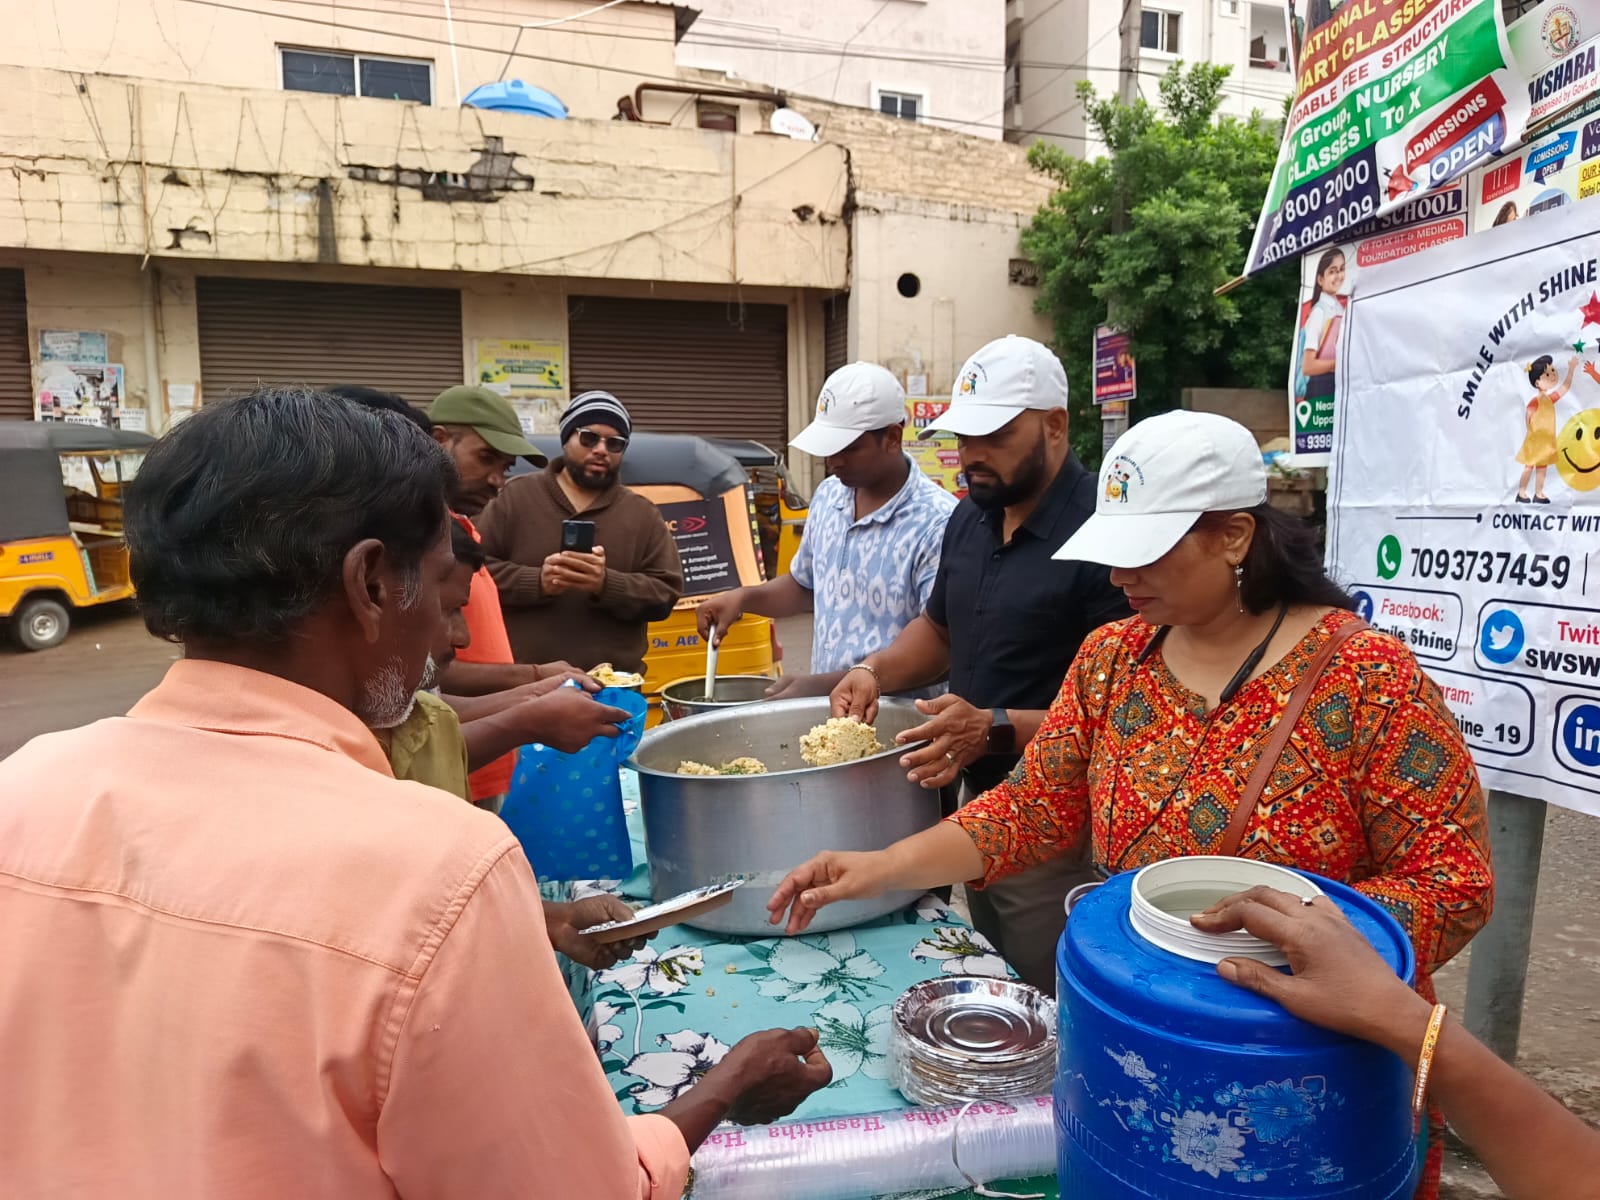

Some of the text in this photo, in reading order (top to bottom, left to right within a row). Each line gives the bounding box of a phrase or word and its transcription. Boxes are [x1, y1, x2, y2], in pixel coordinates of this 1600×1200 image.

[1342, 62, 1370, 92] FEE
[1301, 107, 1351, 148] Group,
[1356, 34, 1449, 112] NURSERY
[1563, 88, 1571, 101] by
[1288, 126, 1360, 185] CLASSES
[1408, 85, 1422, 115] X
[1407, 93, 1487, 164] ADMISSIONS
[1431, 122, 1494, 181] OPEN
[1534, 140, 1569, 164] ADMISSIONS
[1324, 159, 1370, 205] 2000
[1542, 160, 1558, 177] OPEN
[1583, 164, 1597, 179] OUR
[1300, 215, 1333, 248] 008
[1337, 194, 1374, 231] 009
[1381, 191, 1458, 228] SCHOOL
[1416, 221, 1459, 239] MEDICAL
[1361, 242, 1417, 264] FOUNDATION
[1457, 258, 1598, 420] SMILE WITH SHINE
[1492, 513, 1568, 532] CONTACT
[1410, 547, 1572, 590] 7093737459
[1380, 598, 1445, 622] Facebook:
[1410, 627, 1453, 652] Shine
[903, 1102, 1018, 1126] Hasmitha
[768, 1115, 886, 1142] Hasmitha
